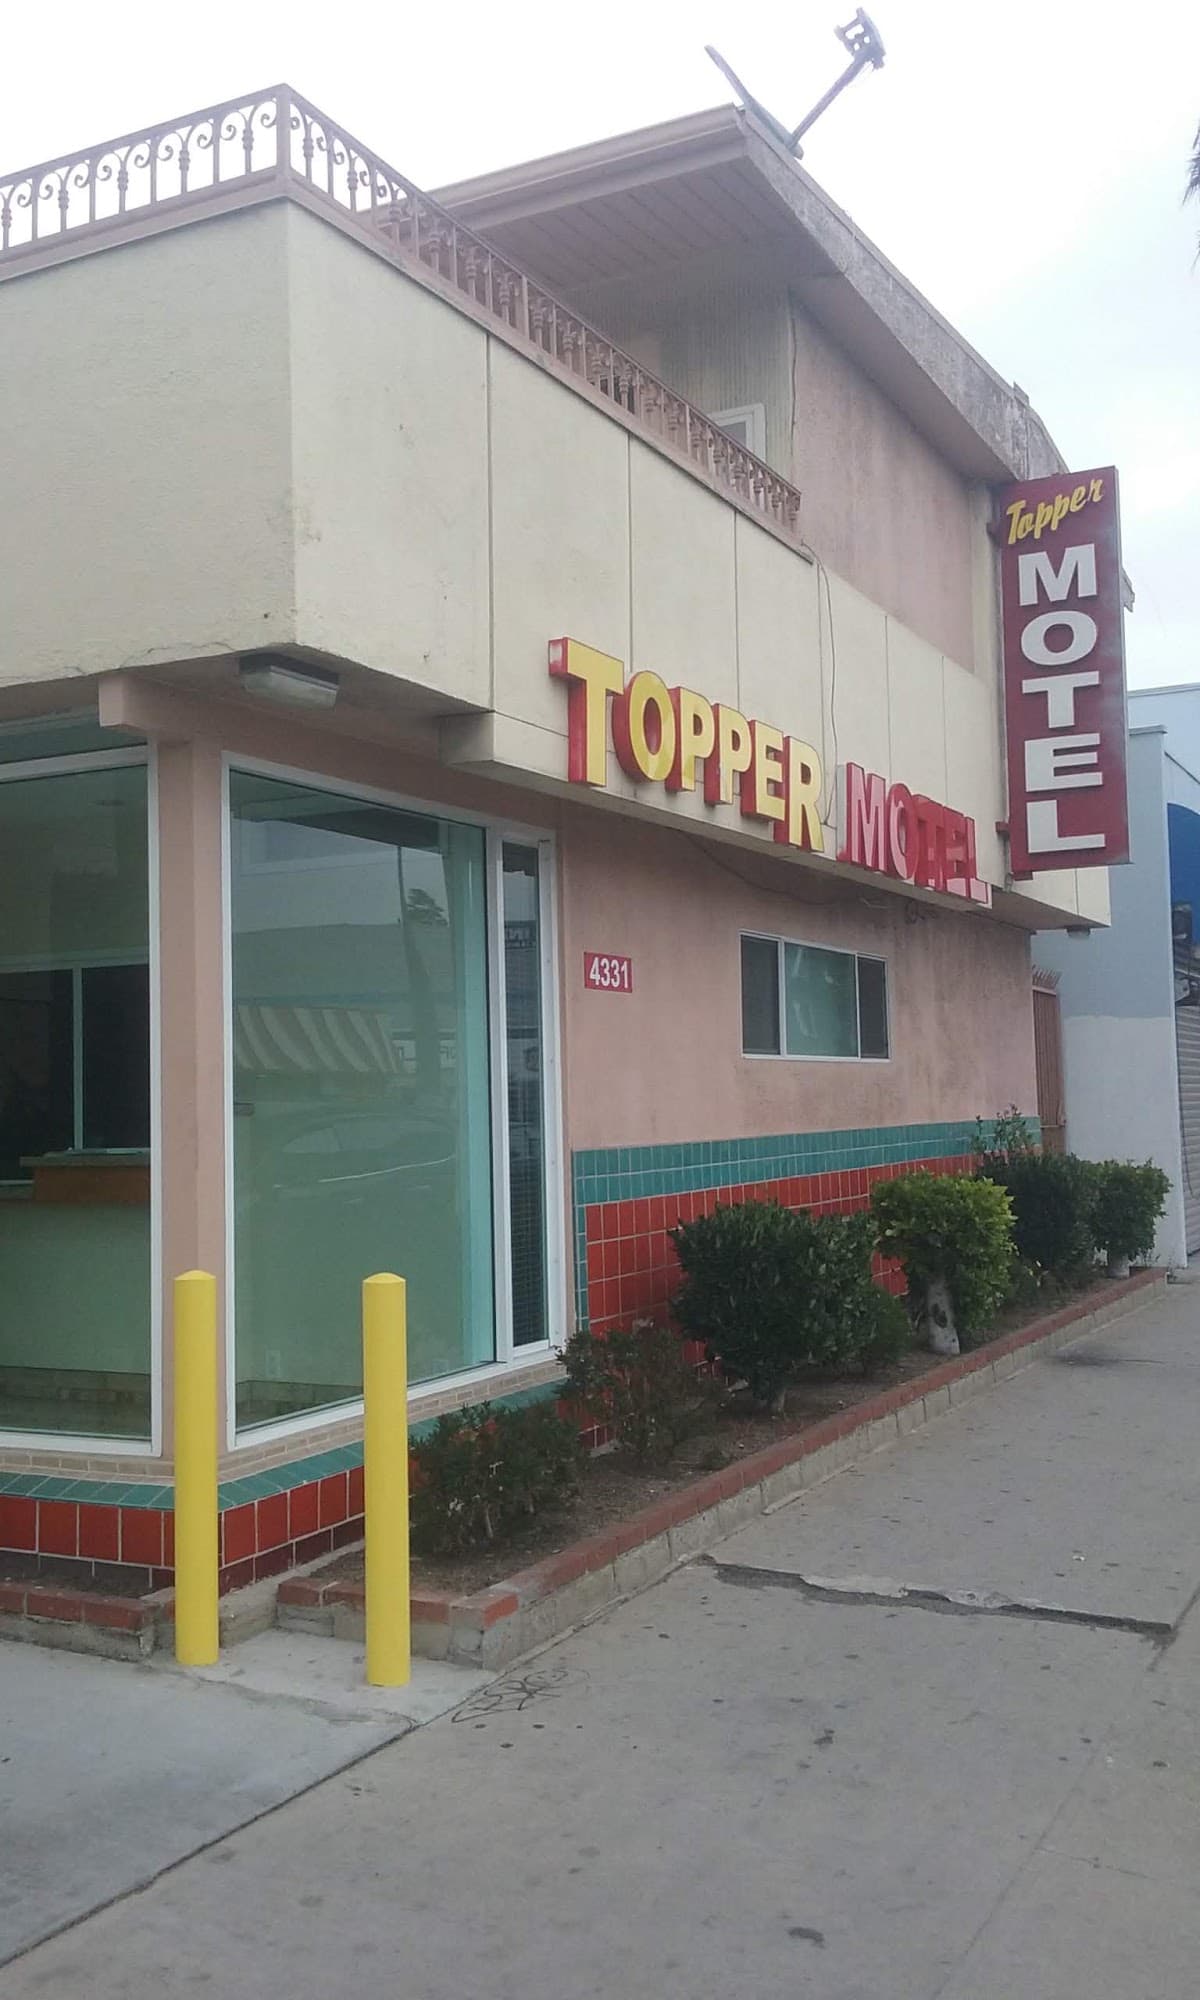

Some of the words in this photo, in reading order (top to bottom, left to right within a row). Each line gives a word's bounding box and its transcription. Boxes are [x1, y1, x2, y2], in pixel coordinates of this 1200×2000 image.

[1006, 479, 1104, 545] Topper
[549, 637, 824, 852] TOPPER
[846, 762, 989, 904] MOTEL
[1017, 543, 1106, 854] MOTEL
[589, 956, 629, 989] 4331
